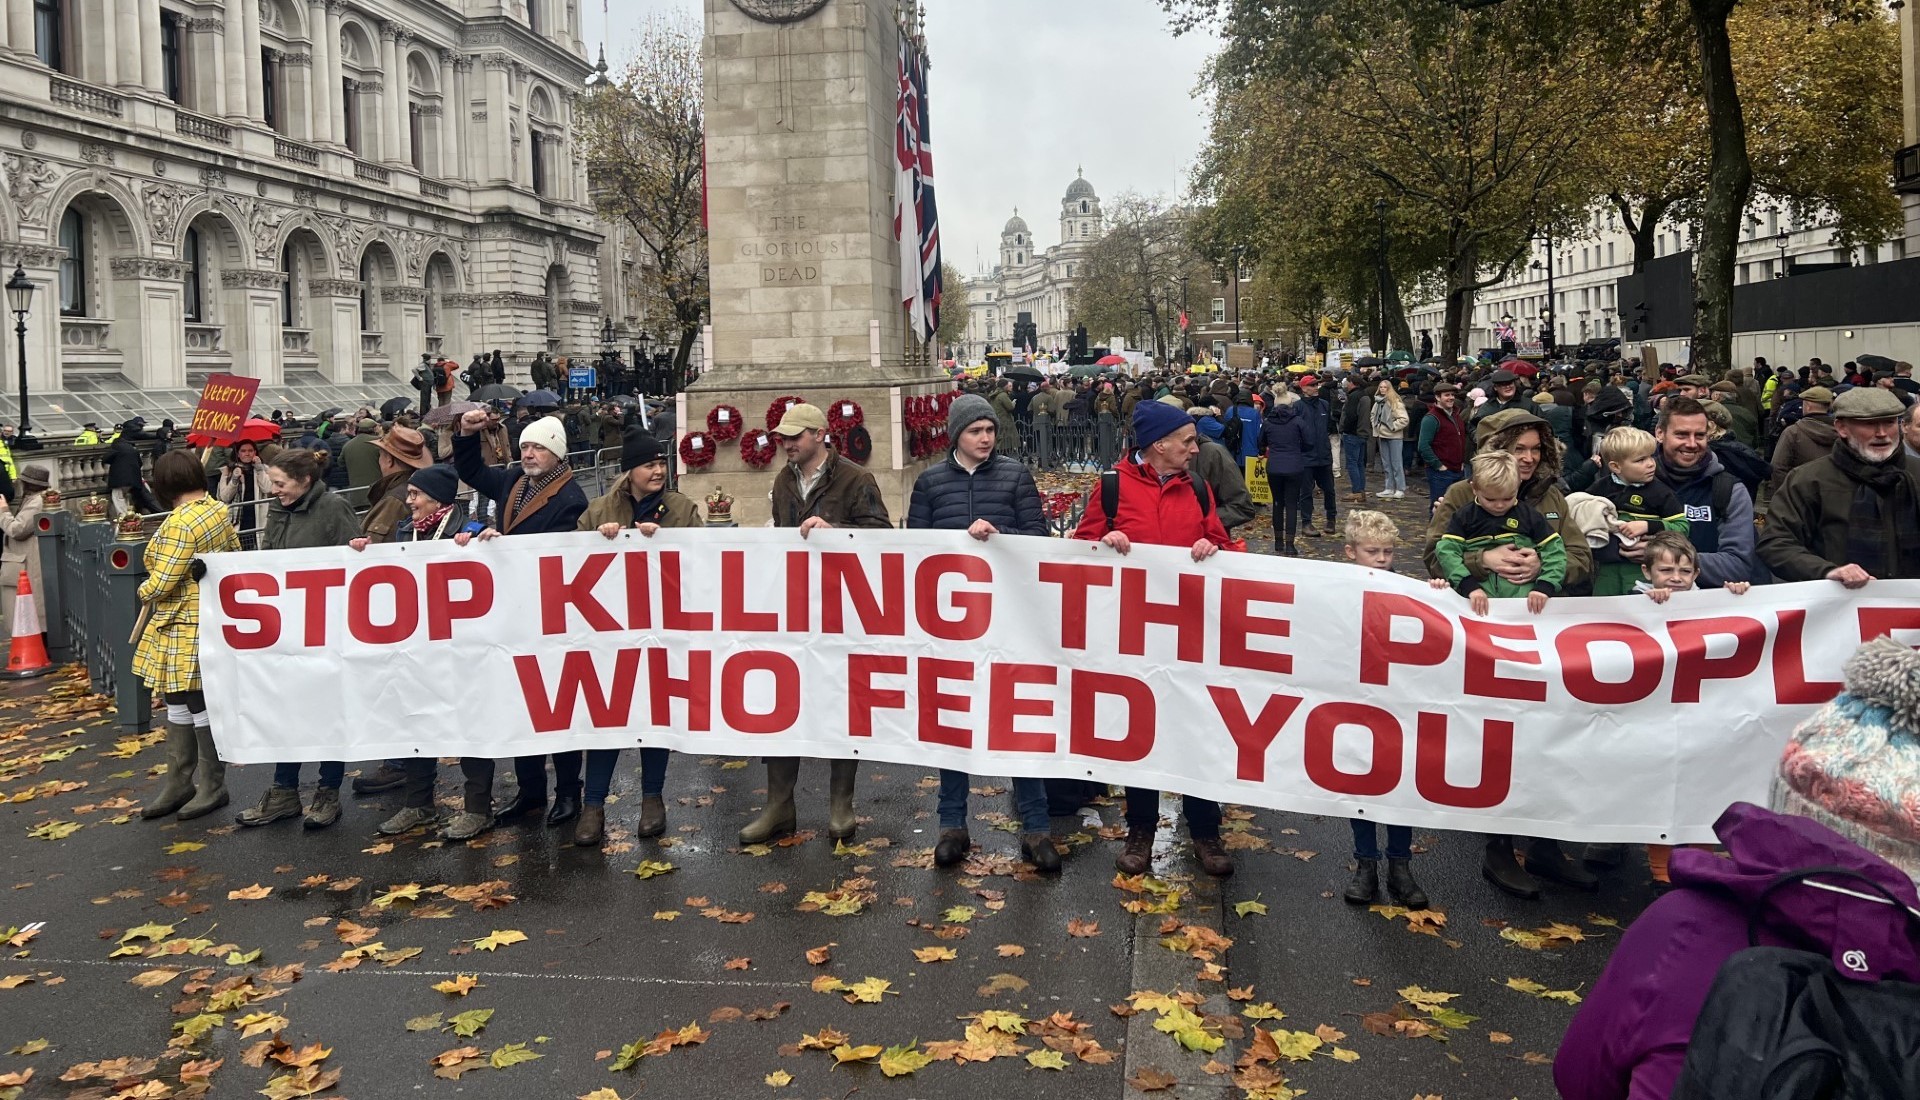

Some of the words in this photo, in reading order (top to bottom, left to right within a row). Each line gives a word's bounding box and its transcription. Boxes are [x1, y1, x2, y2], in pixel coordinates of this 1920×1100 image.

[771, 215, 806, 230] THE
[741, 240, 839, 258] GLORIOUS
[763, 266, 817, 282] DEAD
[191, 408, 240, 433] FECKING
[219, 560, 494, 650] STOP
[540, 550, 993, 641] KILLING
[1039, 562, 1295, 675] THE
[514, 647, 801, 734] WHO
[848, 653, 1156, 762] FEED
[1207, 685, 1514, 809] YOU
